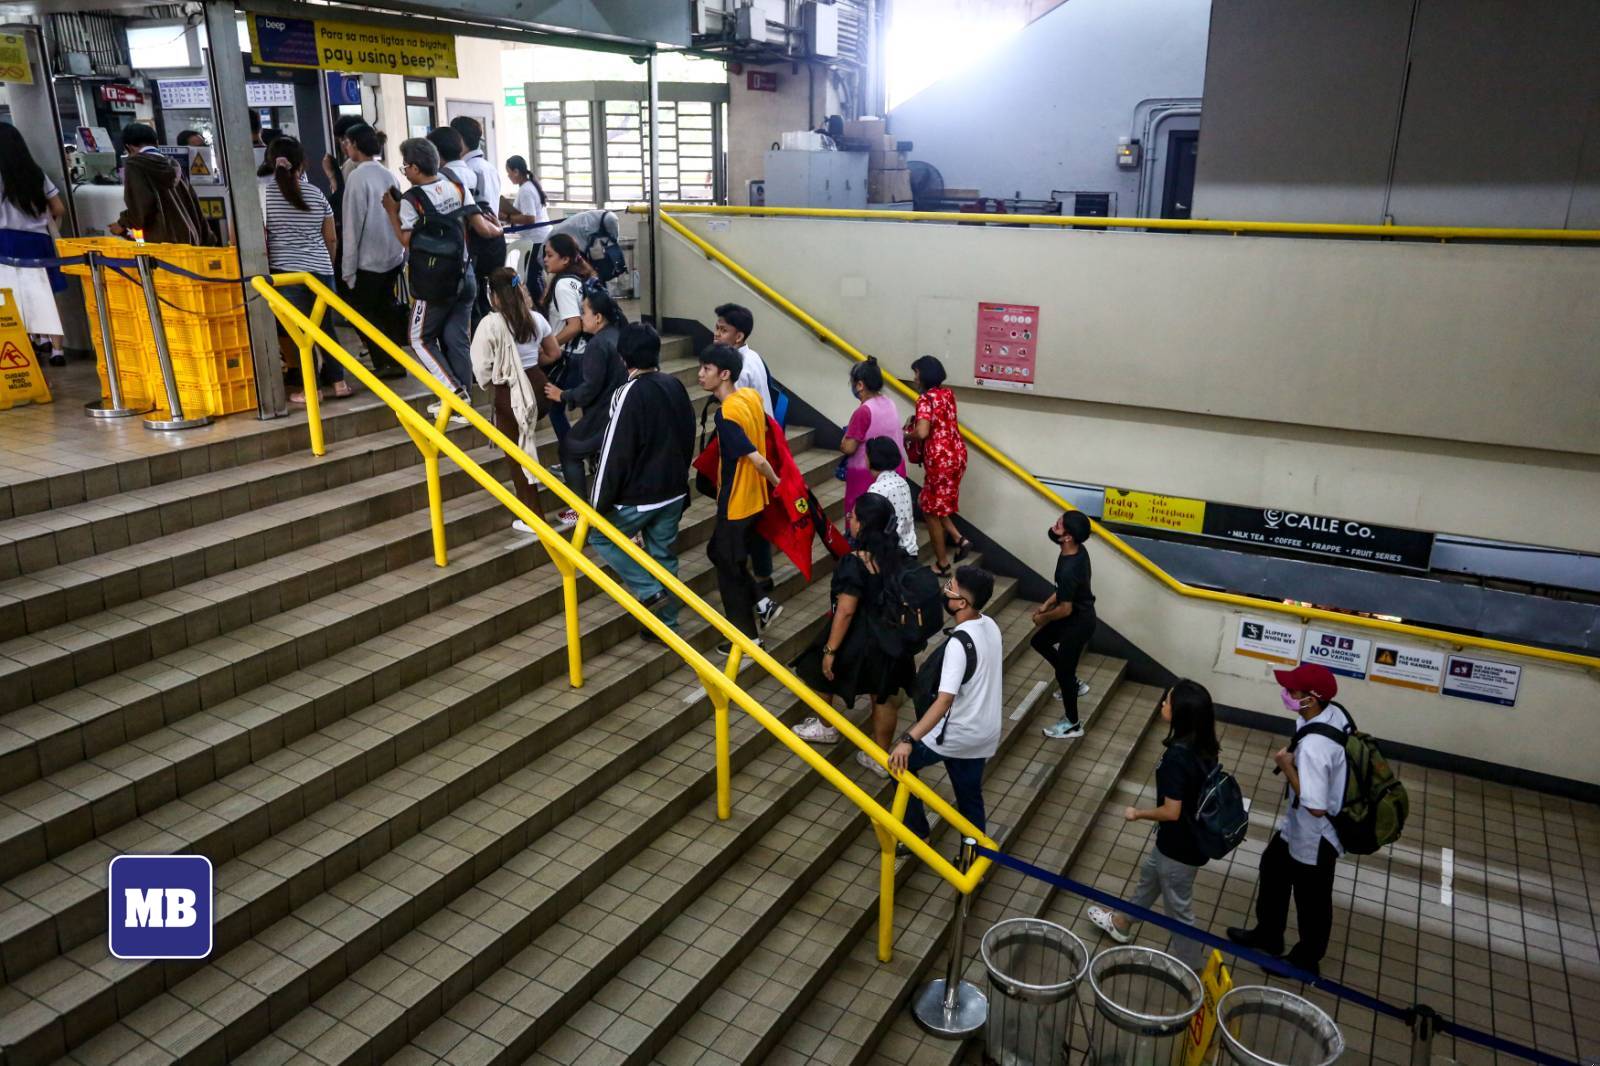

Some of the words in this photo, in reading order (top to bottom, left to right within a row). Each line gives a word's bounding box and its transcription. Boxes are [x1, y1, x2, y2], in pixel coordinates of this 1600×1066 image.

[265, 18, 286, 32] beep
[320, 27, 343, 40] Para
[345, 33, 357, 41] sa
[360, 33, 379, 43] mas
[381, 34, 404, 48] ligtas
[407, 38, 418, 48] na
[324, 47, 354, 65] pay
[360, 48, 397, 68] using
[1285, 513, 1340, 533] CALLE
[1344, 522, 1375, 539] Co.
[1232, 530, 1249, 539] MILK
[1250, 533, 1265, 541] TEA
[1274, 537, 1302, 547] COFFEE
[1311, 543, 1341, 553] FRAPPE
[1351, 549, 1373, 558] FRUIT
[1375, 552, 1402, 562] SERIES
[1264, 629, 1292, 638] SLIPPERY
[1310, 645, 1330, 657] NO
[1331, 649, 1361, 659] SMOKING
[1330, 654, 1355, 662] VAPING
[1409, 662, 1440, 671] HANDRAIL
